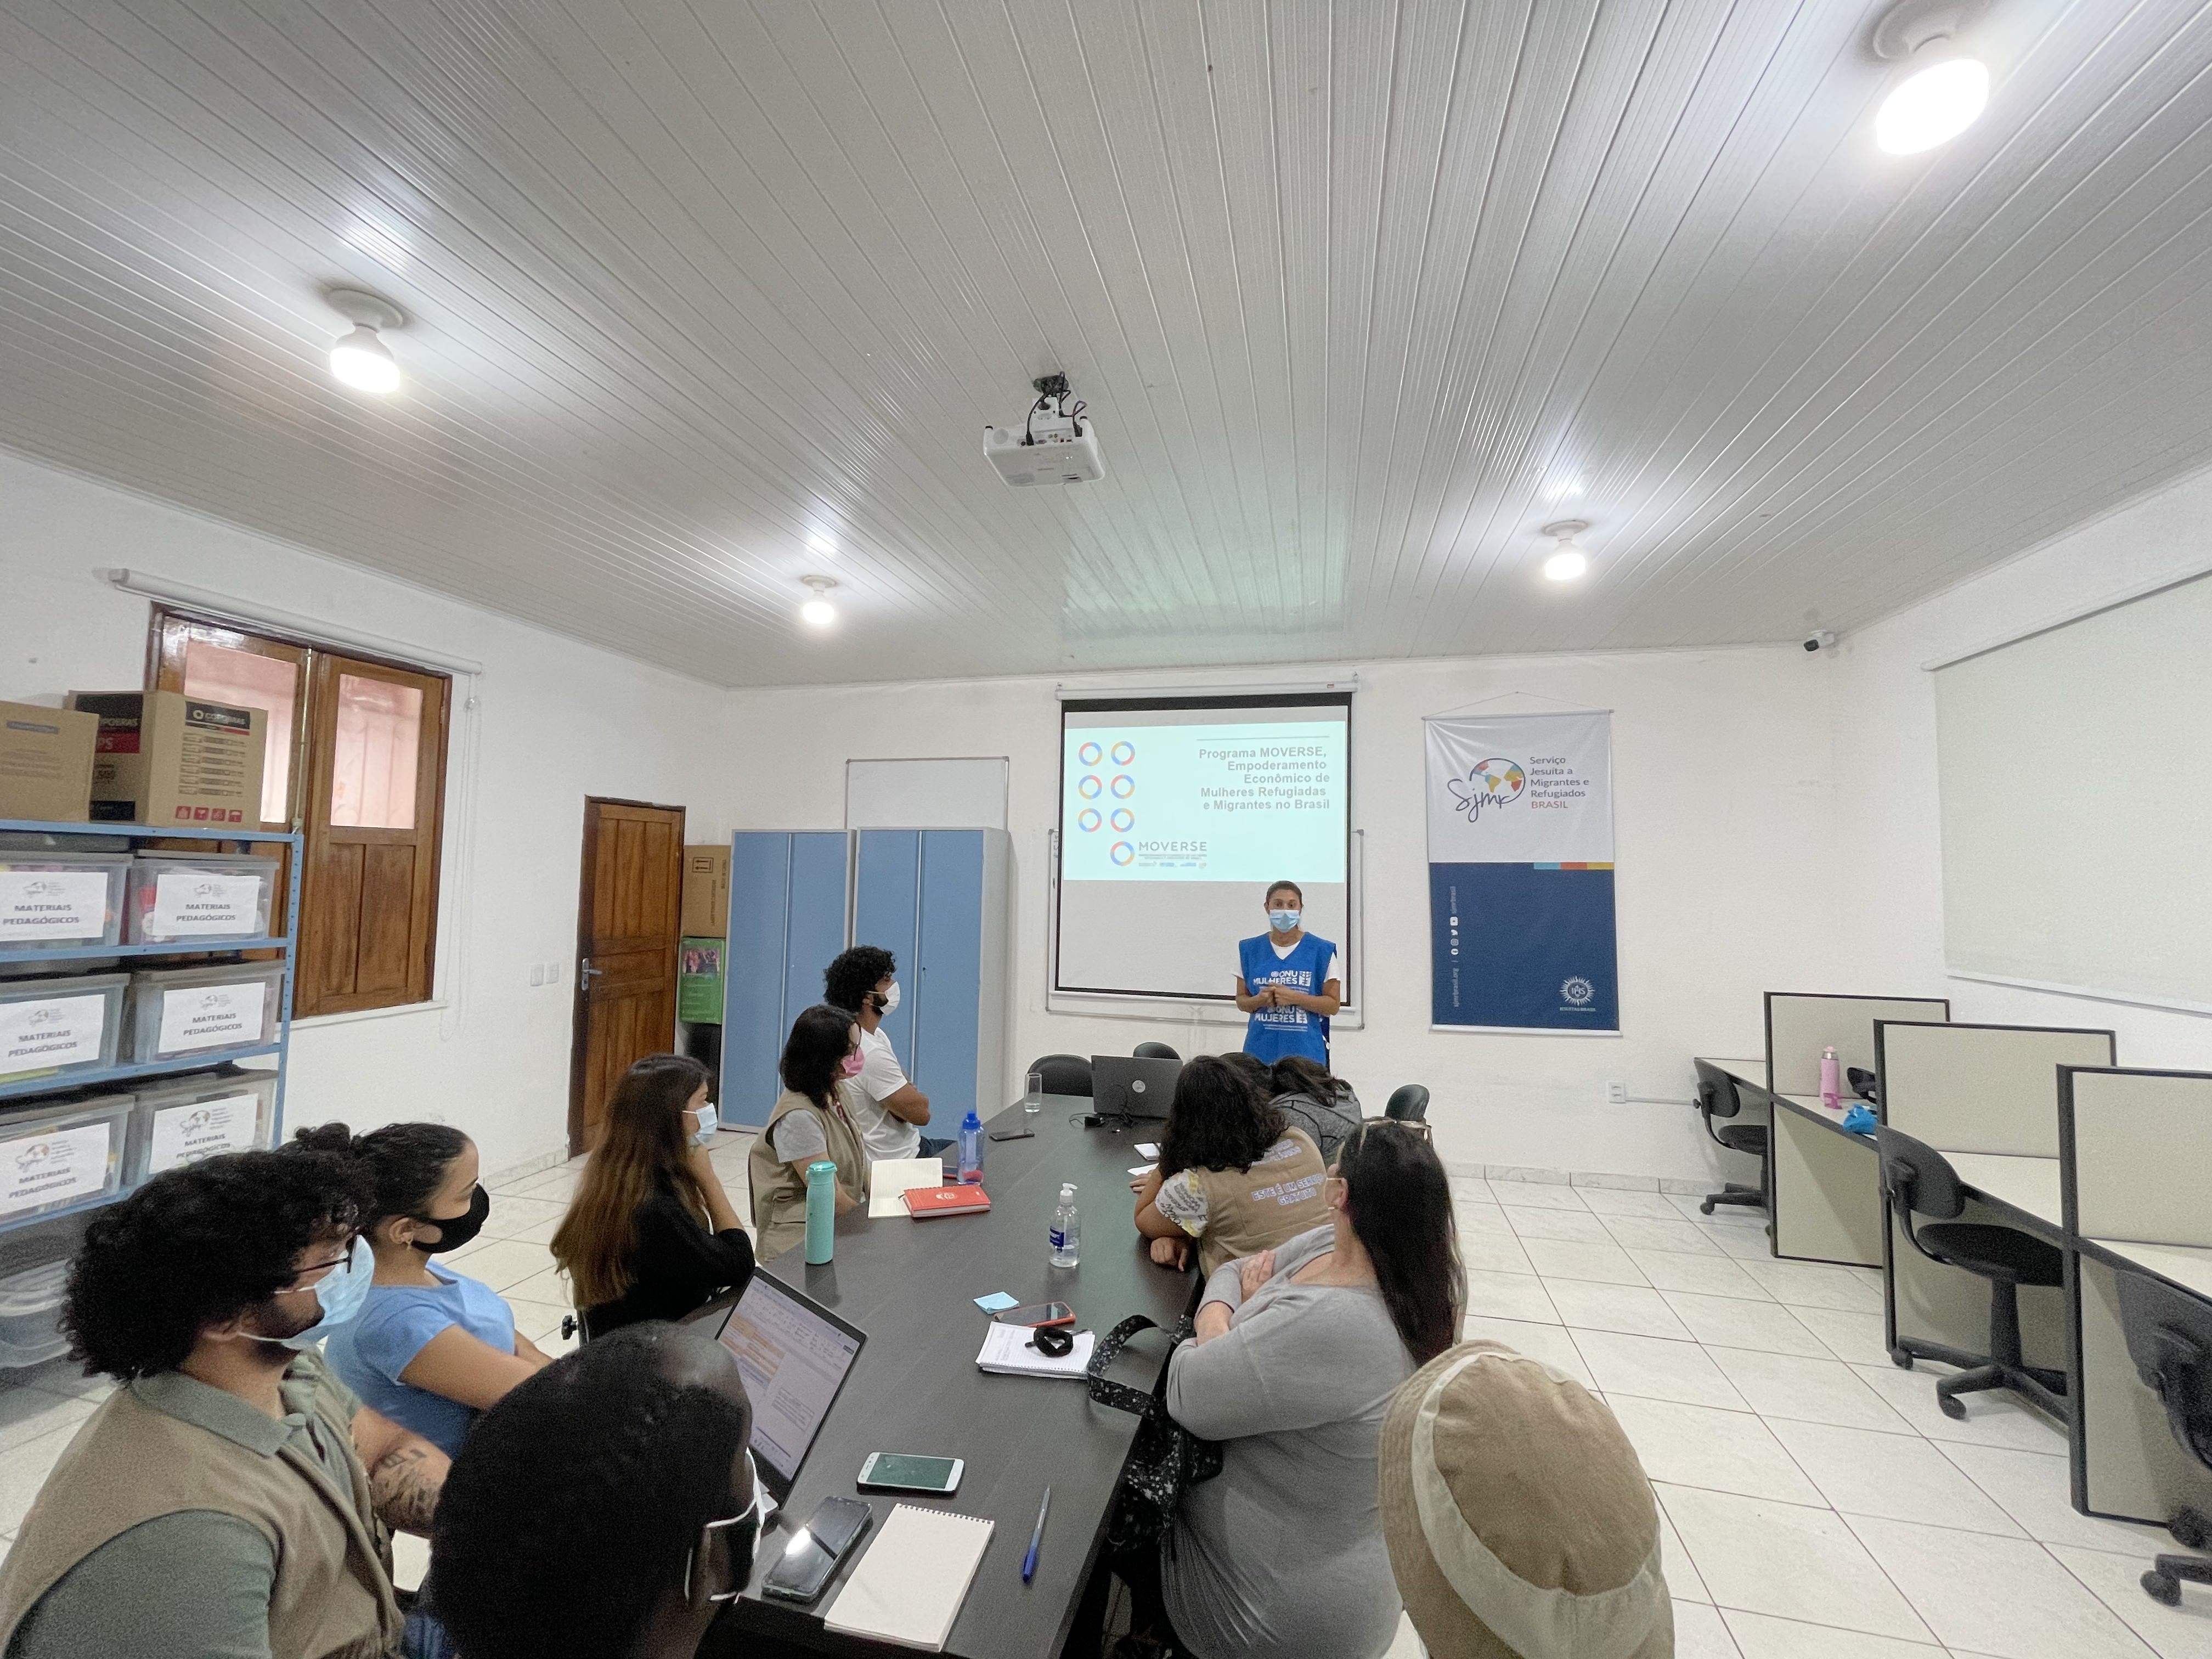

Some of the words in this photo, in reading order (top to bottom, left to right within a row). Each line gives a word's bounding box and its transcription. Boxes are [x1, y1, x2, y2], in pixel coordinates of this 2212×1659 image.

[1199, 749, 1256, 760] Programa
[1260, 746, 1327, 758] MOVERSE,
[1228, 760, 1327, 772] Empoderamento
[1530, 756, 1566, 765] Serviço
[1244, 773, 1311, 783] Econômico
[1316, 772, 1330, 782] de
[1530, 779, 1581, 788] Migrantes
[1201, 787, 1254, 797] Mulheres
[1259, 786, 1326, 799] Refugiadas
[1531, 789, 1586, 799] Refugiados
[1203, 802, 1210, 810] e
[1214, 799, 1272, 812] Migrantes
[1276, 801, 1291, 809] no
[1295, 799, 1330, 809] Brasil
[1531, 801, 1568, 809] BRASIL
[1138, 841, 1207, 851] MOVERSE
[1253, 977, 1297, 985] MULHERES
[192, 1013, 236, 1023] MATERIAIS
[1254, 1013, 1295, 1024] MUJERES
[183, 1023, 242, 1036] PEDAGÓGICOS
[184, 1133, 225, 1147] MATERIAIS
[1252, 1187, 1277, 1200] ESTE
[1275, 1183, 1284, 1195] É
[1283, 1181, 1297, 1193] UM
[1277, 1187, 1317, 1206] GRATUITO
